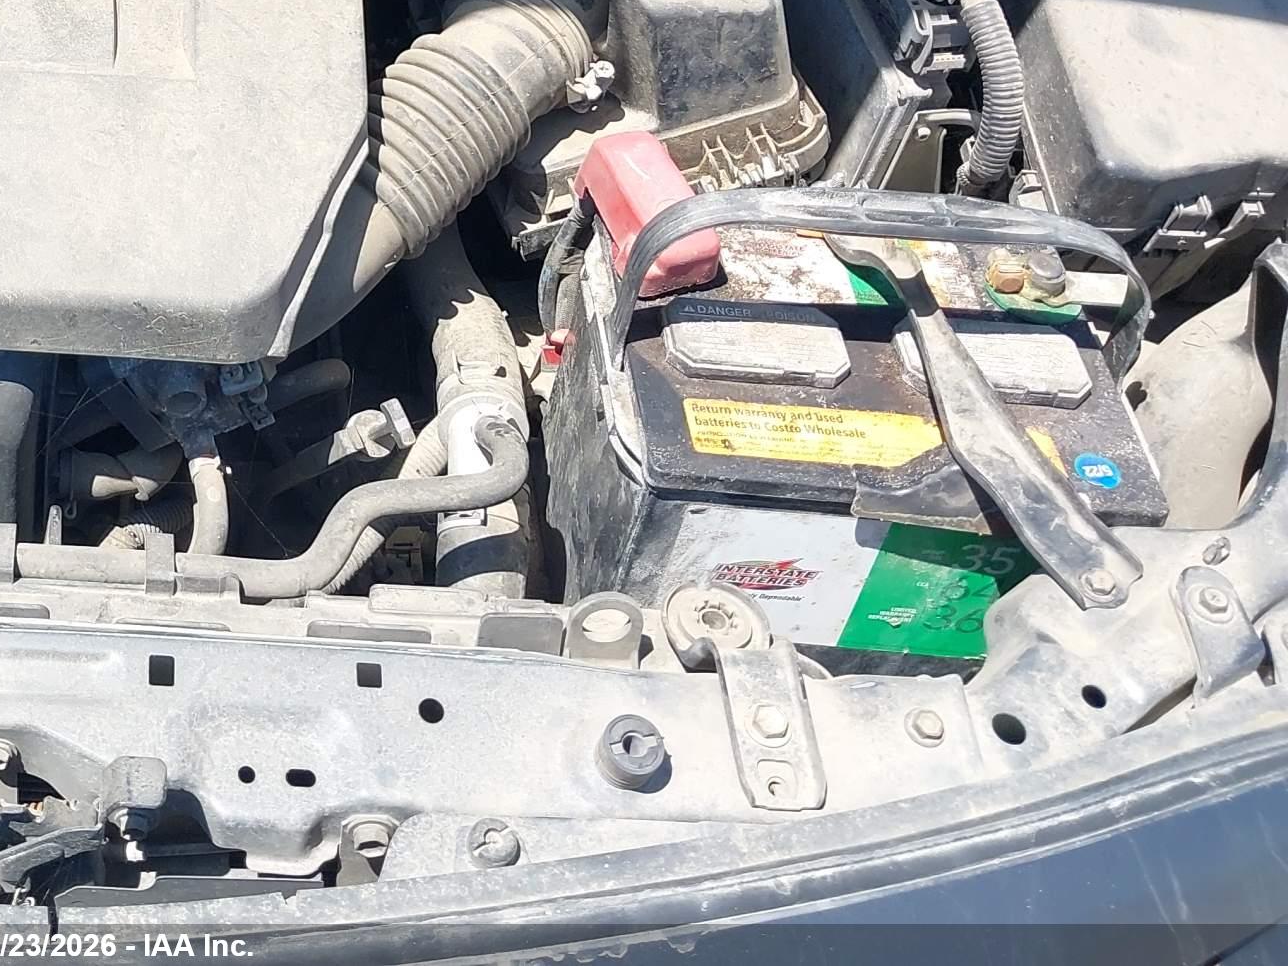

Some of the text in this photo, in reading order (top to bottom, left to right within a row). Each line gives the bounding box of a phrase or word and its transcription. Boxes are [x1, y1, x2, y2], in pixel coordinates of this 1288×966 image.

[696, 305, 752, 317] DANGER
[691, 403, 844, 424] Return warranty and used
[694, 415, 748, 428] batteries
[764, 422, 802, 433] Costco
[803, 424, 867, 438] Wholesale
[951, 544, 1021, 575] 35
[713, 573, 809, 587] BATTERIES
[714, 563, 819, 580] INTERSTATE
